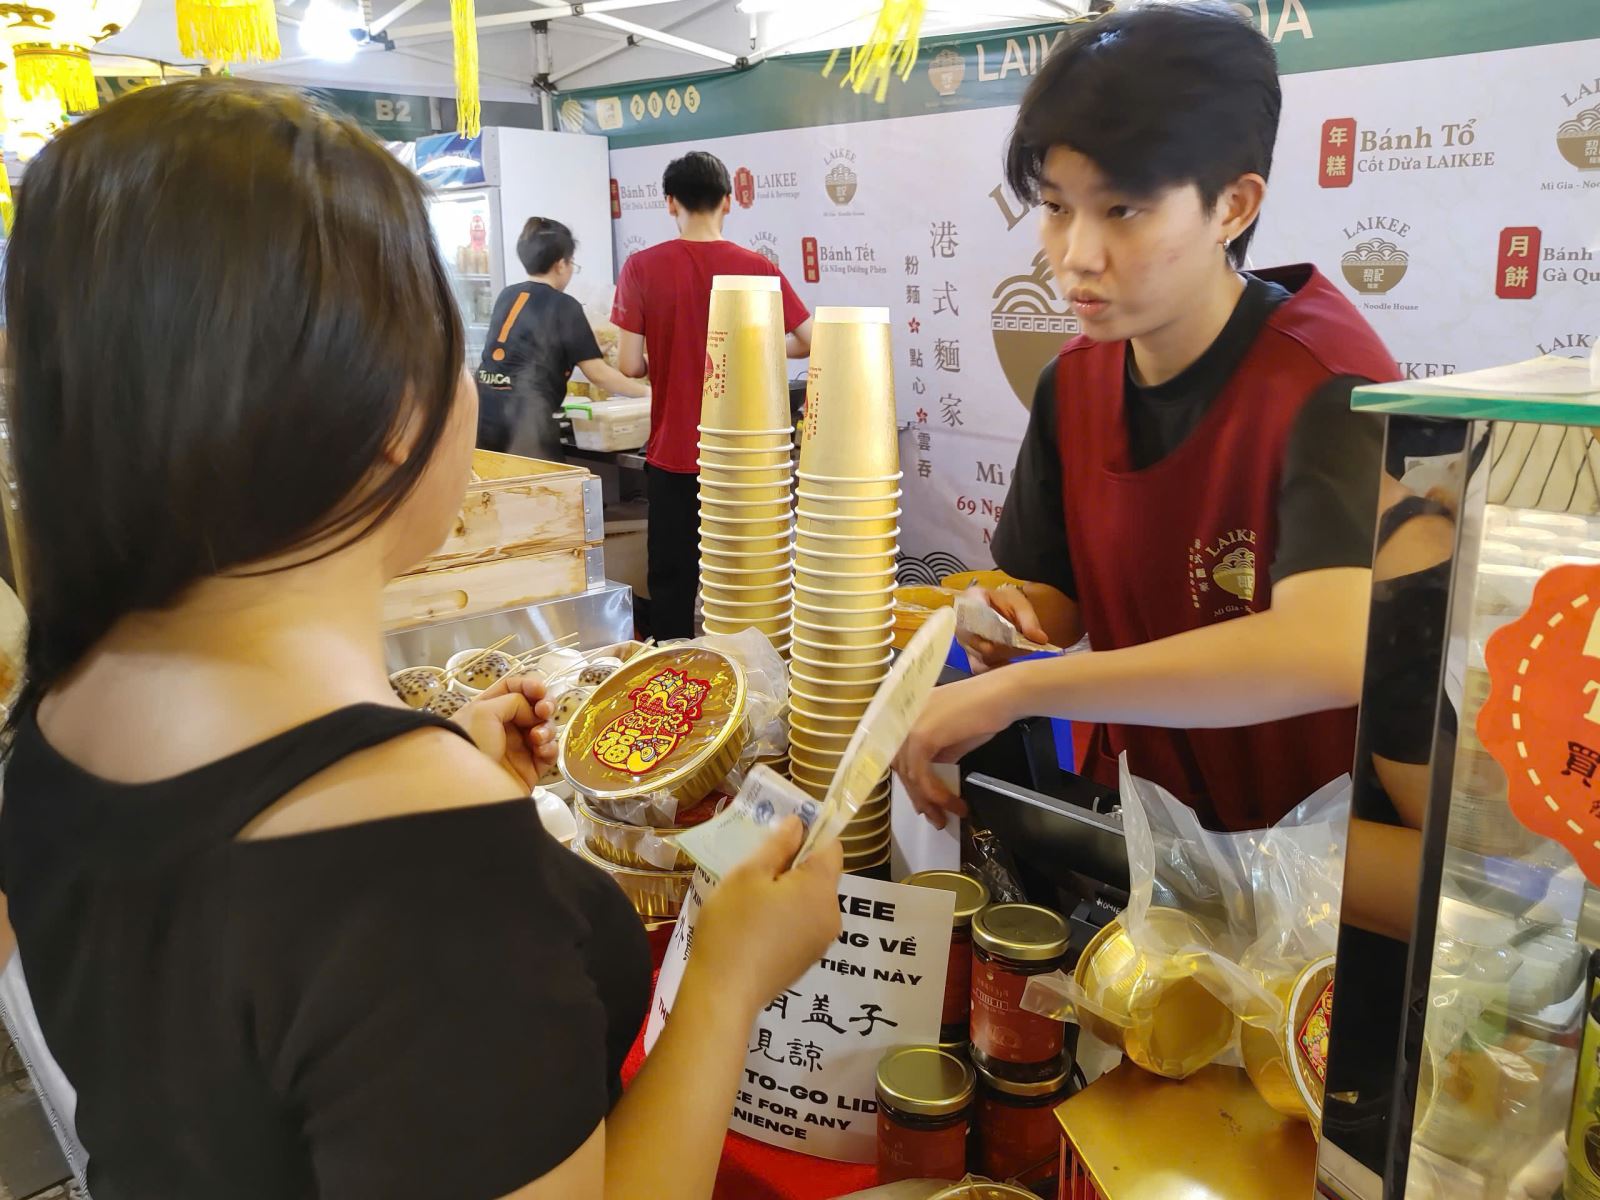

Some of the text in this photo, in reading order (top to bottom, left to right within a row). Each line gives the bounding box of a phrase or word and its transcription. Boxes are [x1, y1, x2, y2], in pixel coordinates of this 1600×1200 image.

[375, 99, 412, 122] B2
[635, 91, 697, 116] 2025
[1360, 118, 1477, 152] Bánh Tổ
[824, 149, 857, 165] LAIKEE
[1326, 126, 1348, 177] 年糕
[1357, 151, 1495, 173] Cốt Dừa LAIKEE
[757, 172, 798, 188] LAIKEE
[1343, 216, 1411, 239] LAIKEE
[820, 246, 852, 261] Bánh
[855, 243, 876, 261] Tết
[1504, 235, 1529, 288] 月餅
[1543, 246, 1593, 261] Bánh
[1543, 267, 1568, 282] Gà
[930, 221, 964, 427] 港式麵家
[976, 461, 1005, 486] Mì
[957, 495, 976, 516] 69
[879, 936, 917, 956] VỀ
[820, 958, 923, 985] TIỆN NÀY
[745, 1068, 829, 1105] TO-GO
[758, 1098, 798, 1119] FOR
[804, 1112, 851, 1131] ANY
